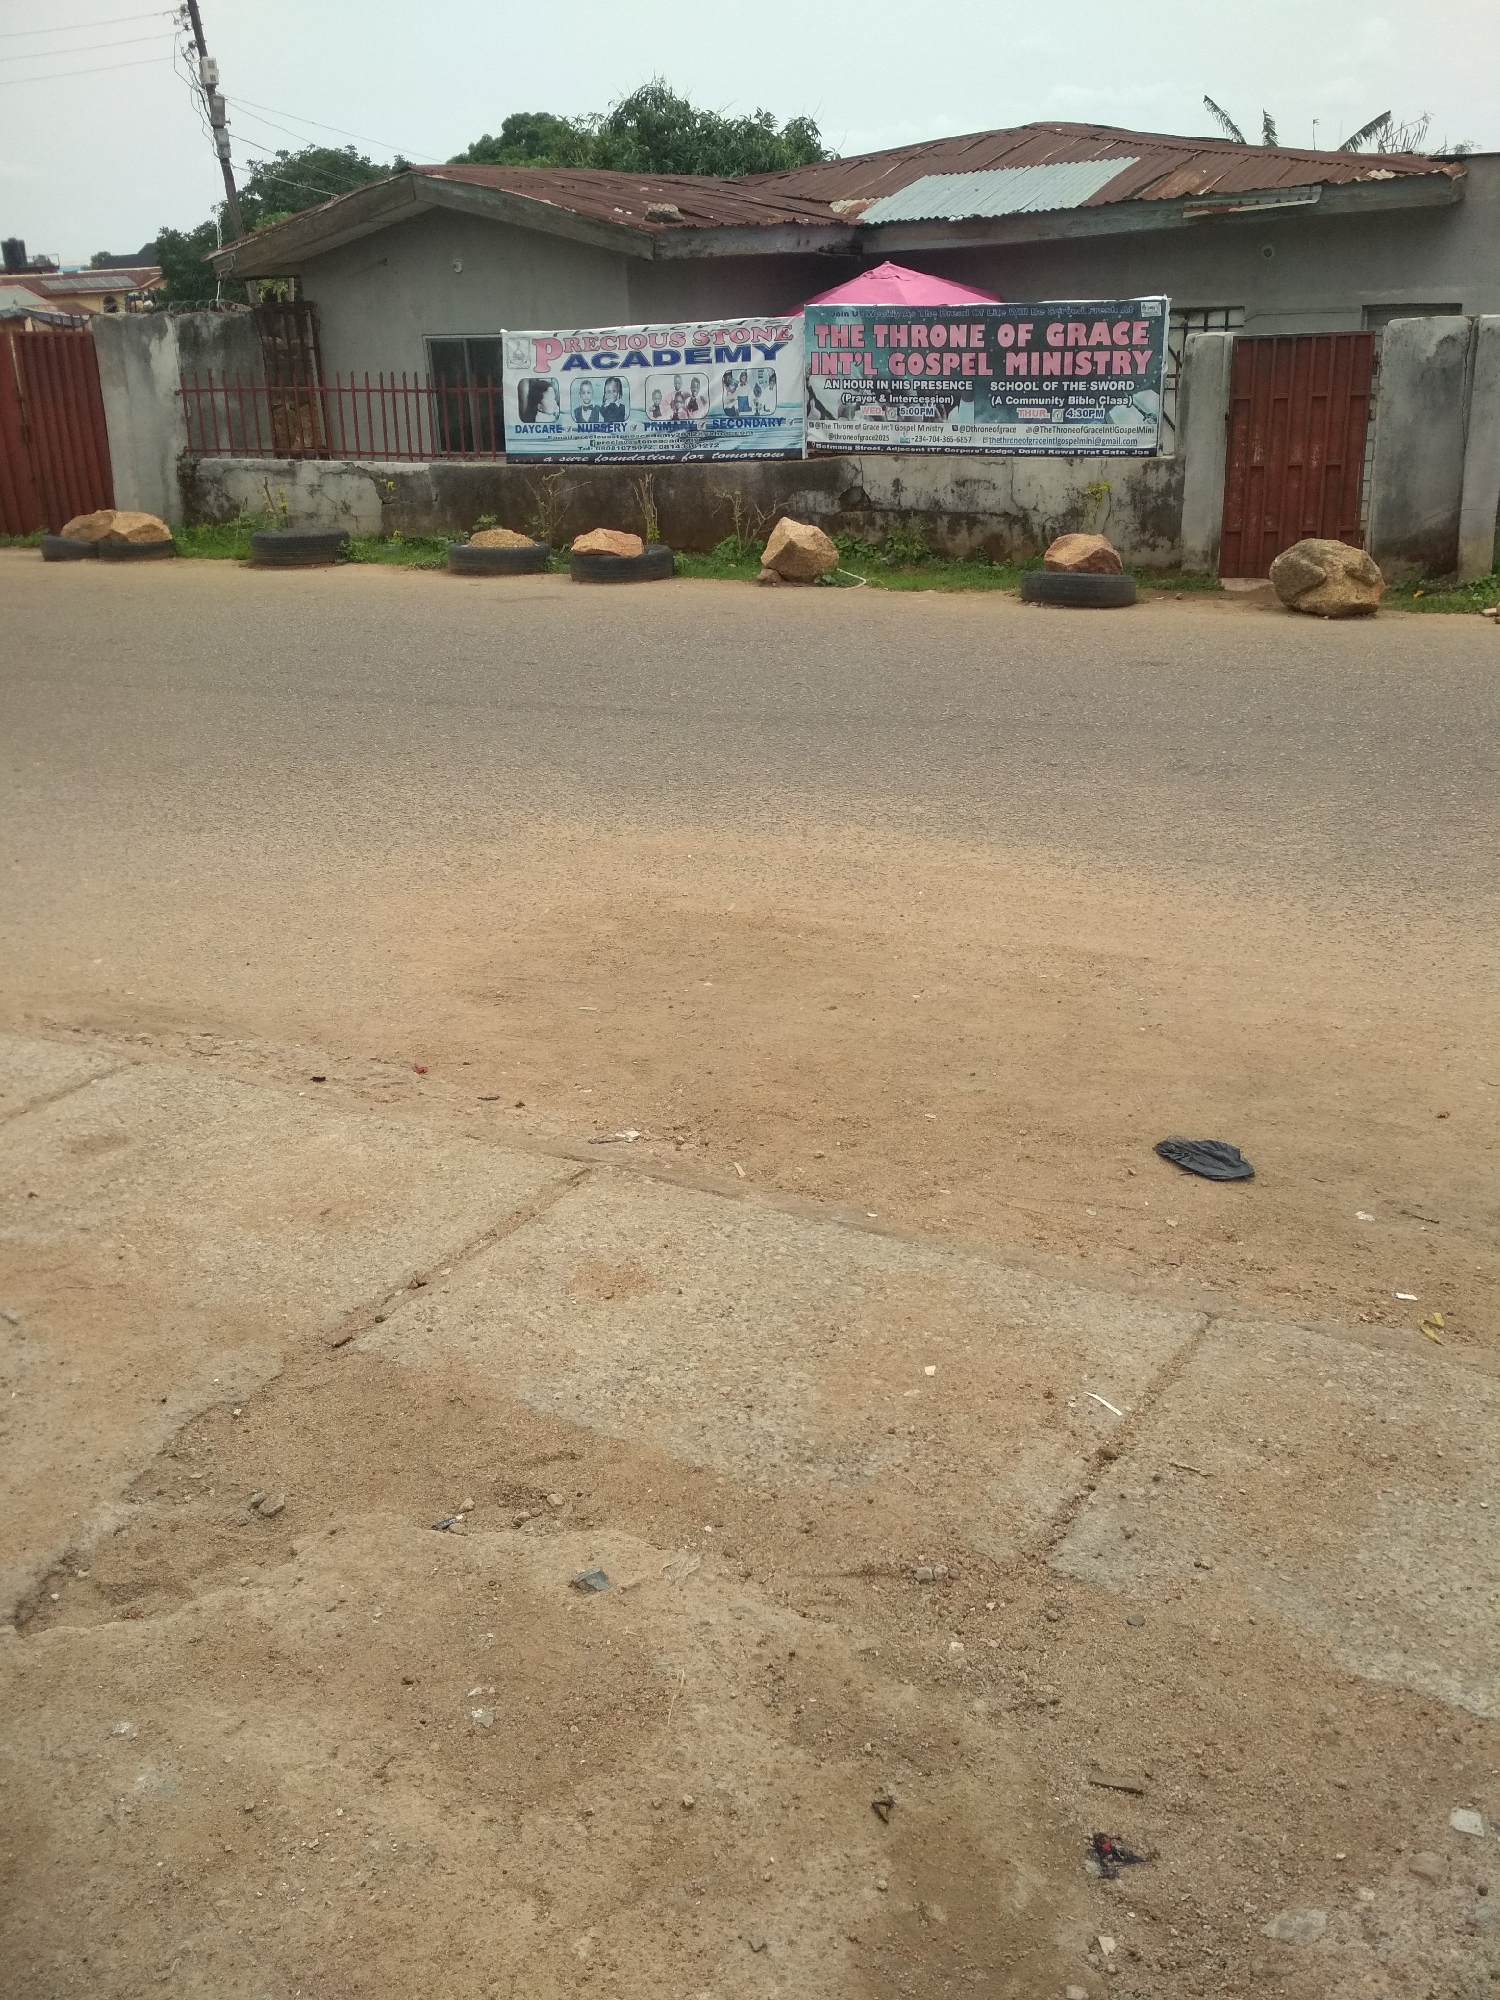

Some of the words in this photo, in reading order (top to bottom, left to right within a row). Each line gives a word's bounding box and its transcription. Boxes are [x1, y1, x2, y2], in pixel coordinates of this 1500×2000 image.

[830, 309, 849, 318] Join
[851, 309, 864, 318] Us
[918, 309, 938, 318] The
[986, 307, 1007, 317] Life
[1009, 307, 1029, 316] Will
[1031, 307, 1045, 316] Be
[814, 324, 866, 348] THE
[873, 324, 986, 348] THRONE
[997, 323, 1034, 348] OF
[1046, 320, 1150, 347] GRACE
[532, 331, 687, 374] PRECIOUS
[692, 324, 794, 347] STONE
[560, 342, 788, 372] ACADEMY
[810, 351, 878, 375] INT'L
[888, 350, 993, 376] GOSPEL
[1005, 350, 1154, 376] MINISTRY
[824, 379, 840, 389] AN
[843, 379, 874, 389] HOUR
[877, 379, 888, 389] IN
[891, 380, 911, 390] HIS
[913, 380, 973, 390] PRESENCE
[990, 381, 1039, 391] SCHOOL
[1042, 381, 1059, 391] OF
[1062, 381, 1087, 391] THE
[1090, 380, 1135, 391] SWORD
[841, 394, 877, 405] (Prayer
[879, 394, 887, 403] &
[889, 394, 954, 405] Intercession)
[991, 396, 1003, 407] (A
[1005, 396, 1065, 407] Community
[1068, 396, 1096, 405] Bible
[1098, 395, 1133, 407] Class)
[900, 407, 934, 416] 5:00PM
[1066, 408, 1105, 418] 4:30PM
[515, 424, 563, 434] DAYCARE
[577, 422, 628, 433] NURSERY
[643, 420, 695, 432] PRIMARY
[712, 417, 783, 429] SECONDARY
